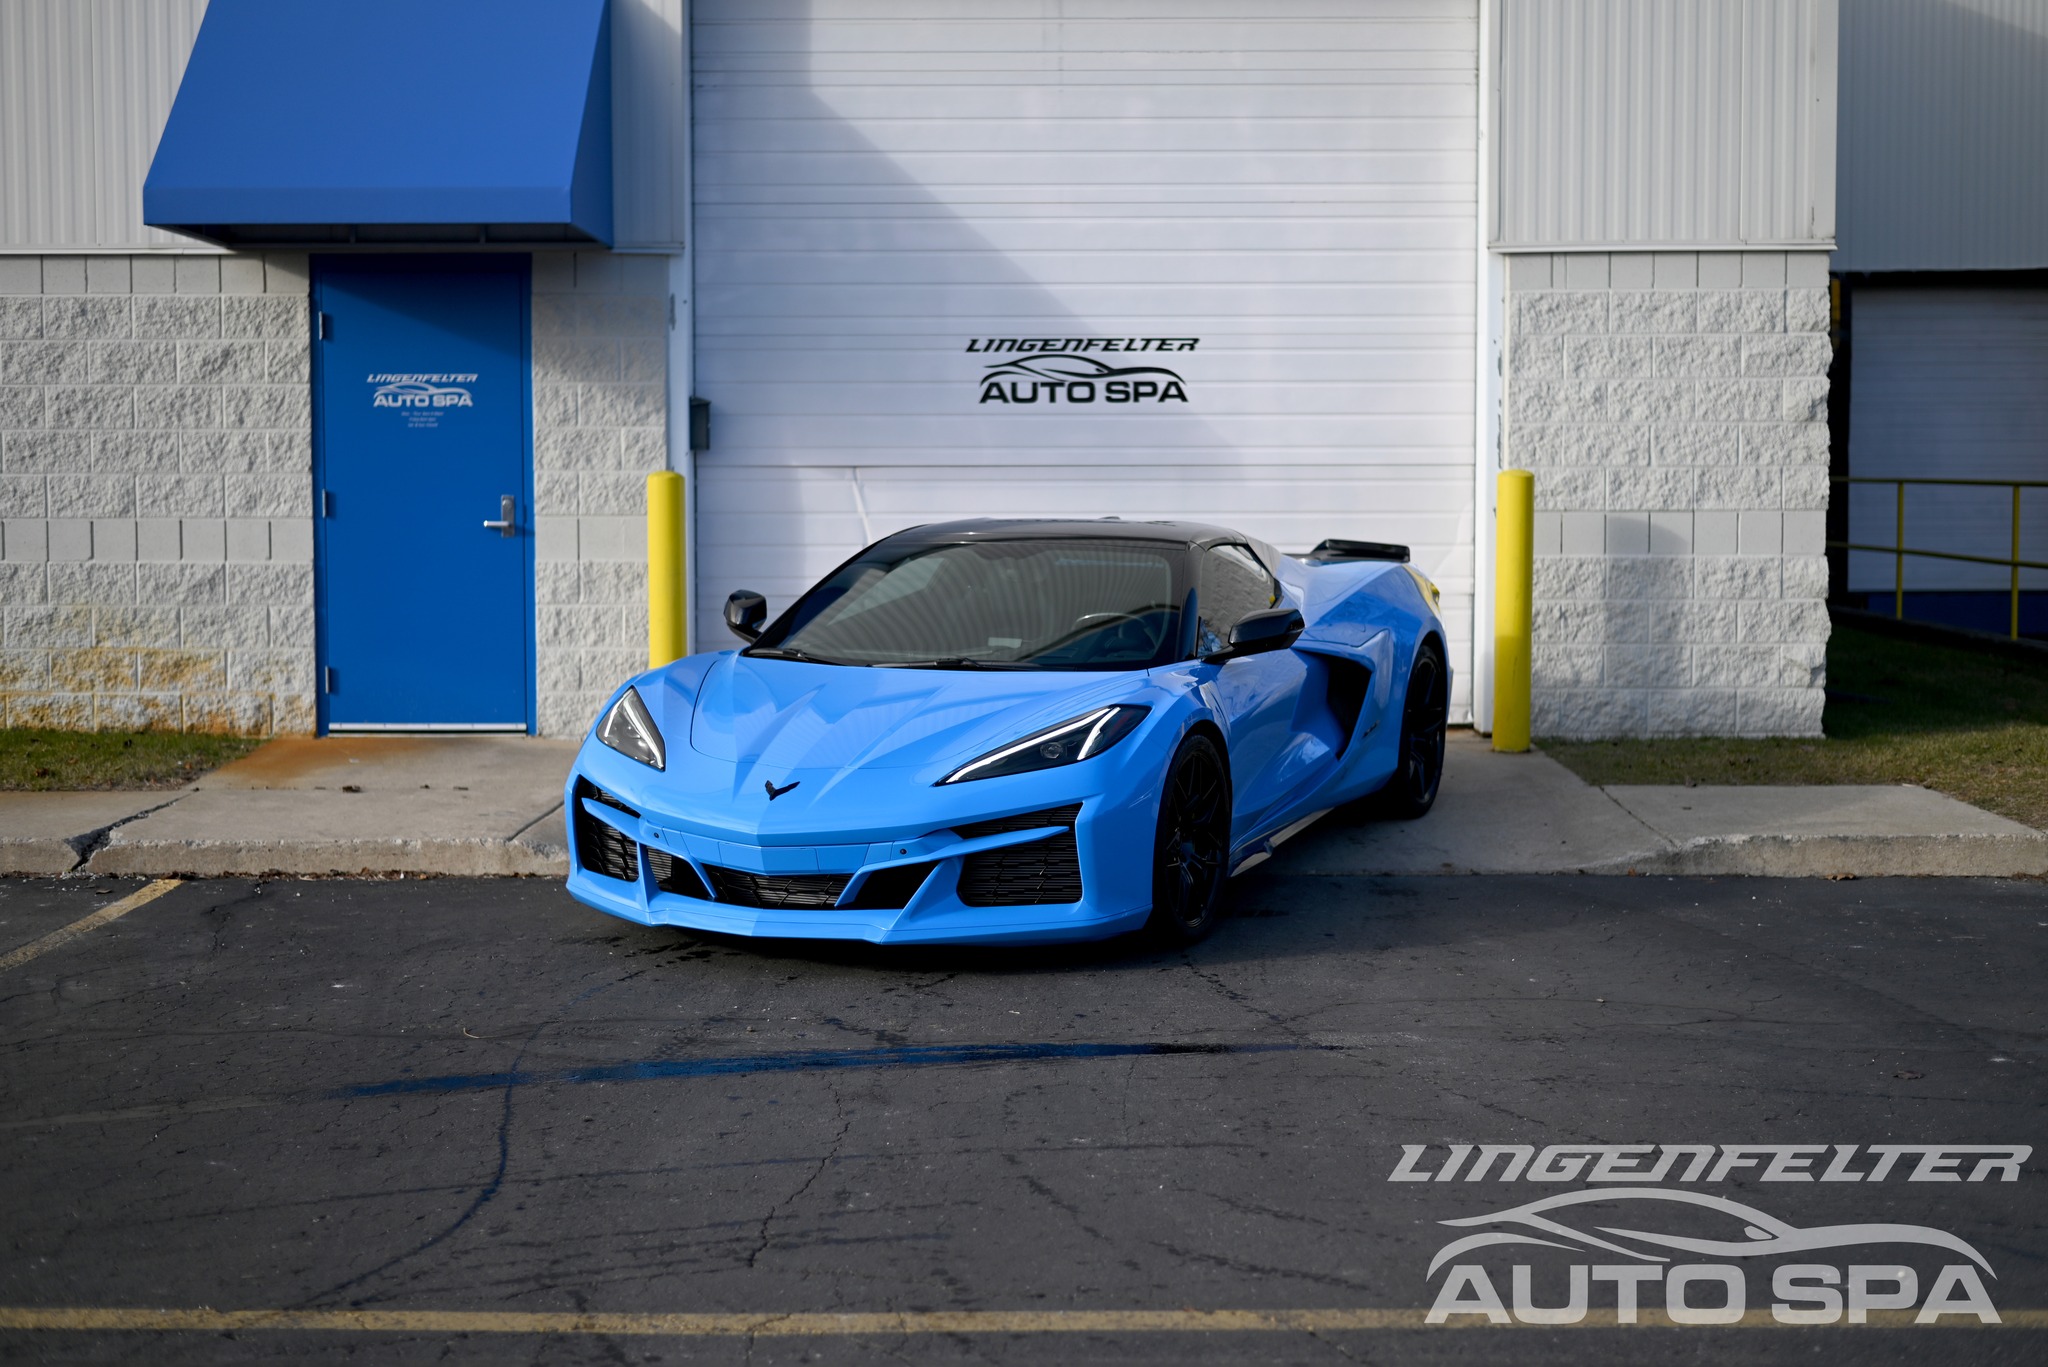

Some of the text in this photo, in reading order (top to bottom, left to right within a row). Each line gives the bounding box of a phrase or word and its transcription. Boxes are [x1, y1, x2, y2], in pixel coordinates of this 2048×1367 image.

[966, 338, 1200, 352] LINGENFELTER
[366, 373, 478, 383] LINGENFELTER
[979, 381, 1189, 404] AUTO SPA
[373, 395, 473, 407] AUTO SPA
